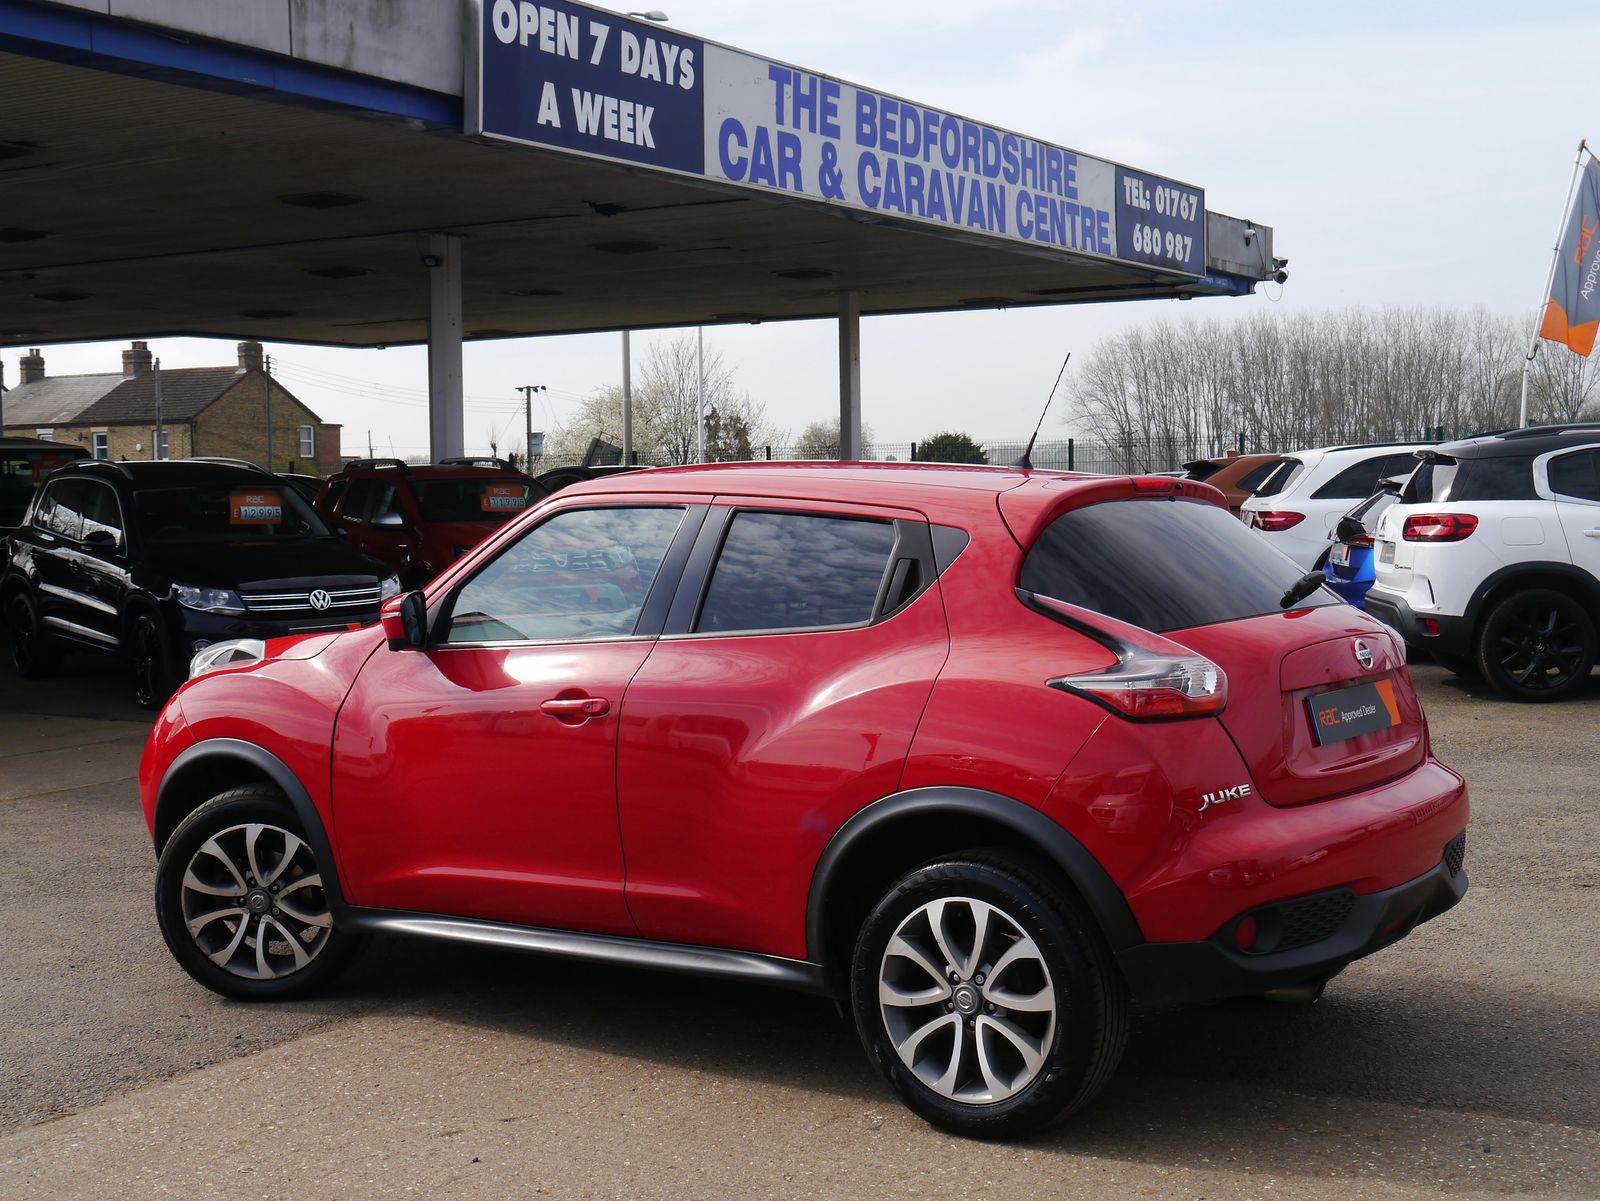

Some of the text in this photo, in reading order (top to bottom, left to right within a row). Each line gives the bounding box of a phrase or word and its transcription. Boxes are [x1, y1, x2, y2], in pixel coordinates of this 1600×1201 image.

[492, 0, 695, 90] OPEN 7 DAYS
[536, 81, 656, 149] A WEEK
[769, 64, 1079, 199] THE BEDFORDSHIRE
[718, 117, 1111, 256] CAR & CARAVAN CENTRE
[1123, 175, 1198, 222] TEL: 01767
[1132, 223, 1192, 263] 680 987
[1581, 240, 1600, 300] Approve
[1341, 707, 1363, 724] Approved
[1362, 704, 1377, 716] Dealer
[1197, 784, 1251, 812] JUKE
